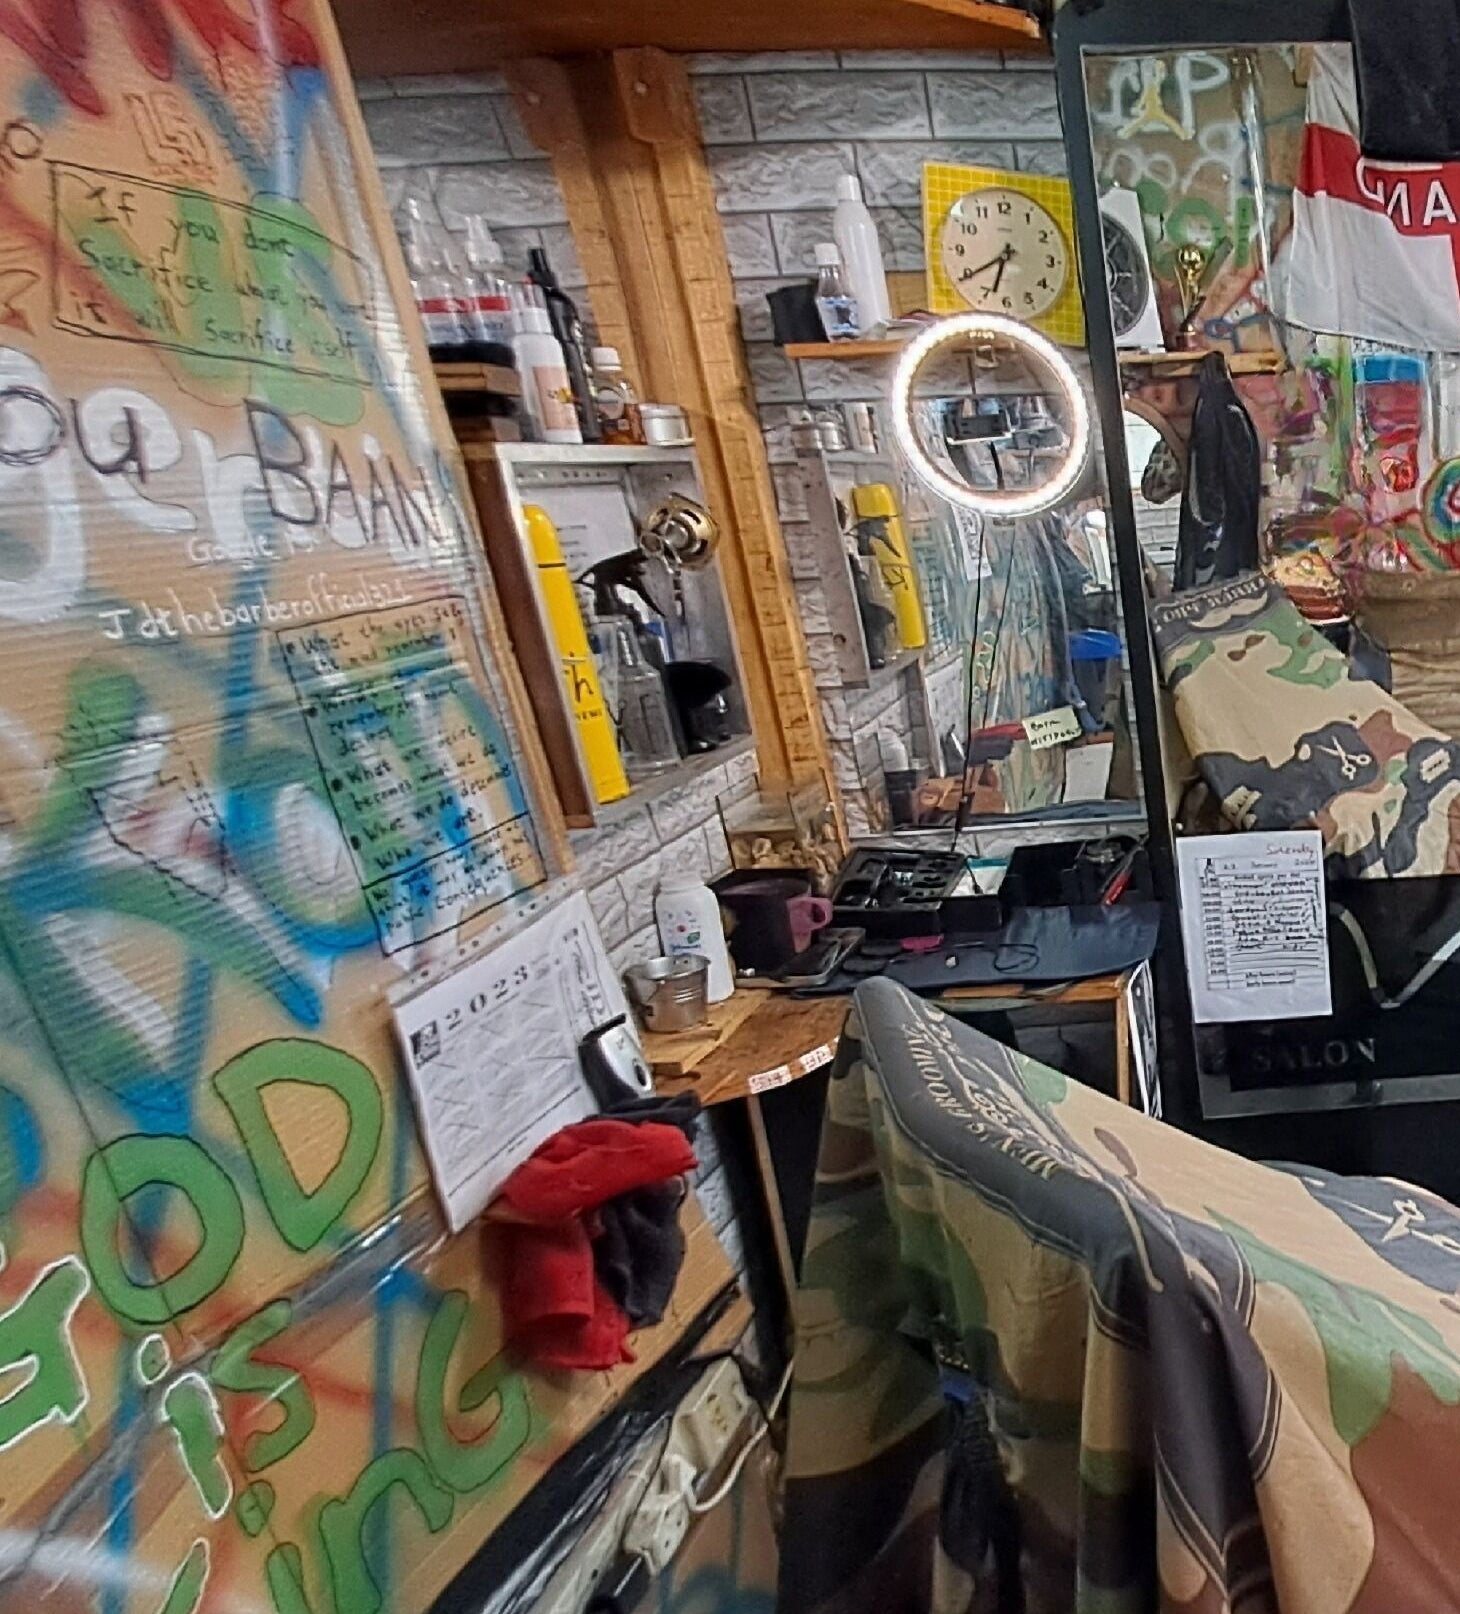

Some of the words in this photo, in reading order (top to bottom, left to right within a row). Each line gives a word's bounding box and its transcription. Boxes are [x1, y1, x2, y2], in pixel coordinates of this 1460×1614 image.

[976, 206, 988, 219] 11
[997, 202, 1012, 215] 12
[961, 223, 978, 236] 10
[1038, 229, 1049, 244] 2
[955, 244, 965, 257] 9
[1046, 254, 1055, 269] 3
[1037, 277, 1048, 290] 4
[980, 285, 991, 298] 7
[1024, 291, 1034, 305] 5
[1001, 296, 1012, 309] 6
[444, 963, 531, 1034] 2023
